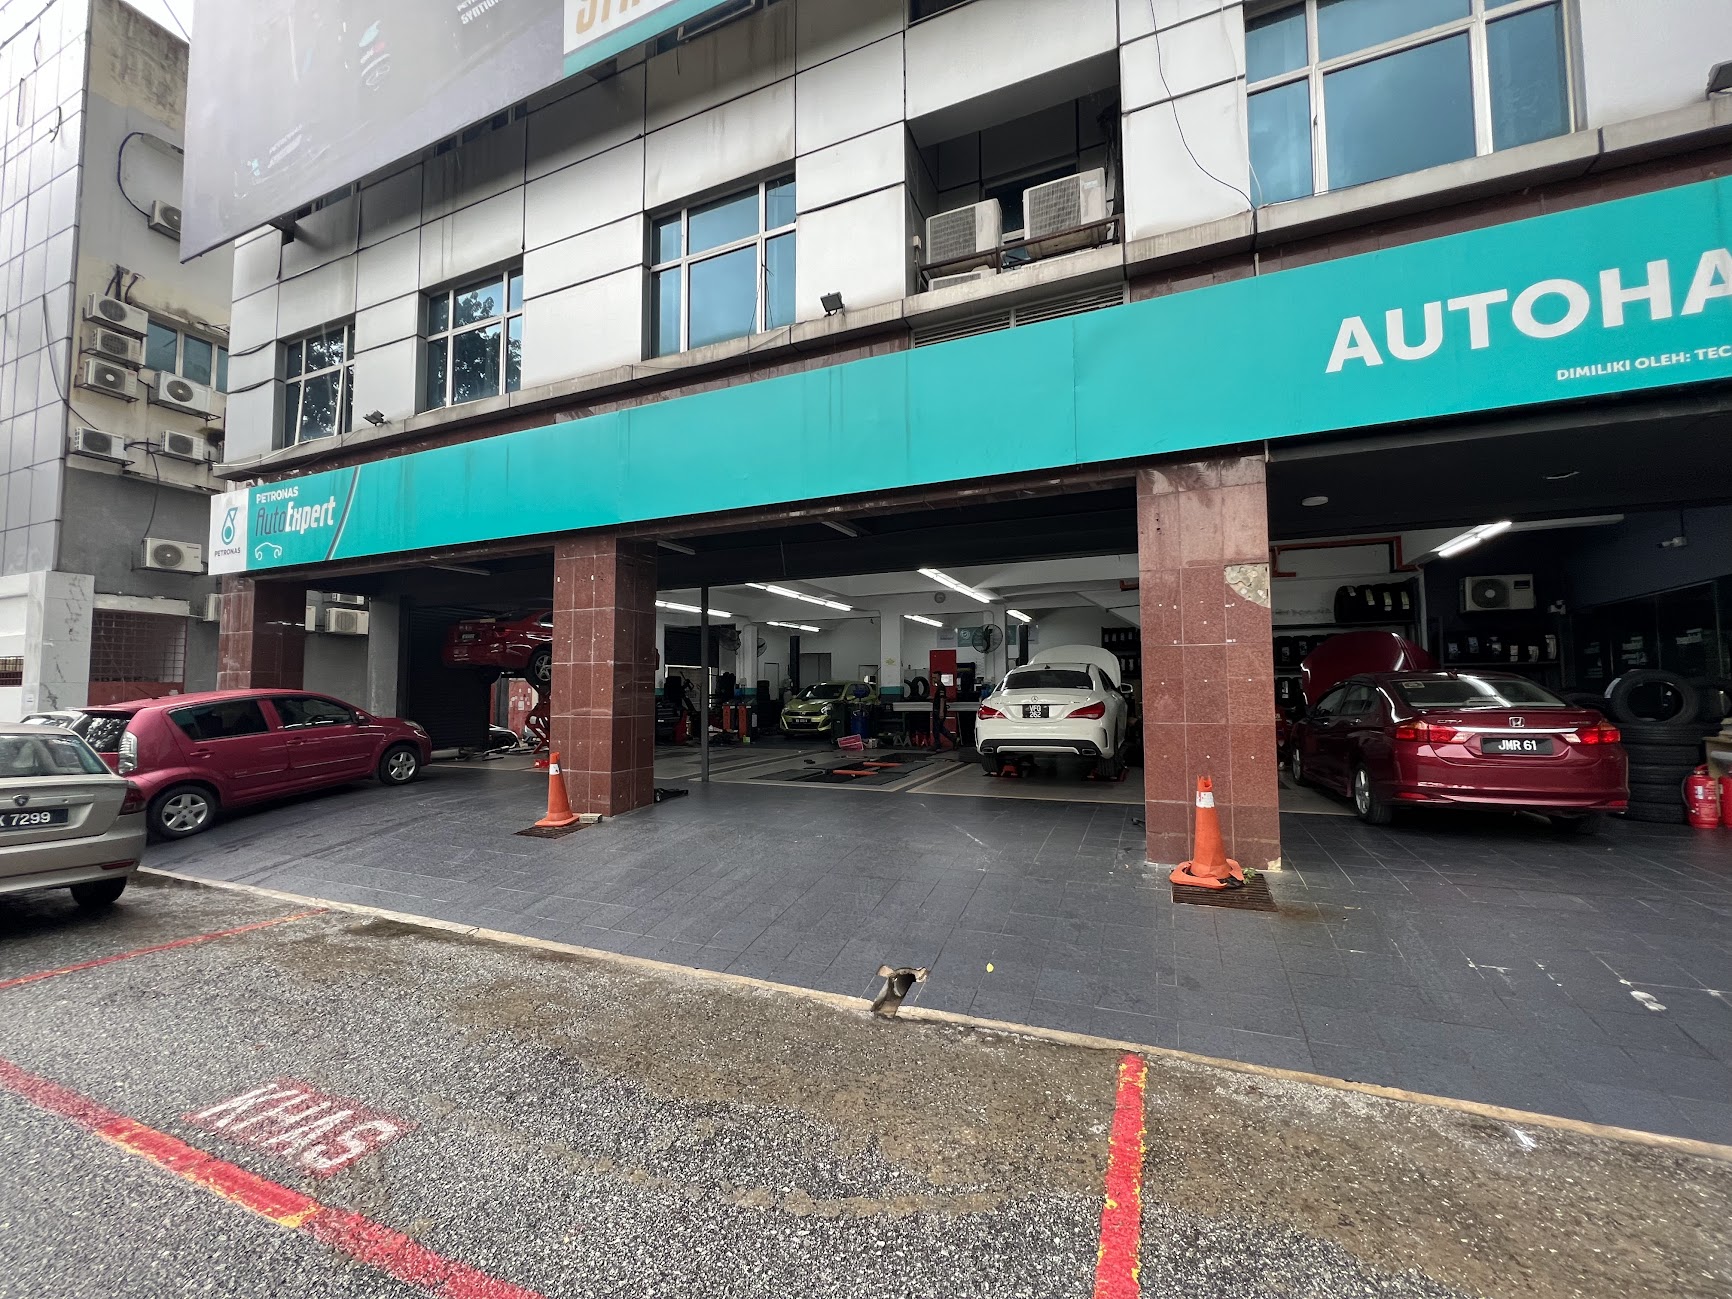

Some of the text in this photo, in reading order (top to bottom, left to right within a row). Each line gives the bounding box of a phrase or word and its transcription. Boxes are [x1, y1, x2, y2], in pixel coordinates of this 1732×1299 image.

[461, 0, 499, 24] SYNTIU
[1325, 248, 1732, 373] AUTOHA
[1557, 345, 1732, 381] DIMILIKI OLEH: TEC
[256, 486, 299, 504] PETRONAS
[214, 547, 241, 557] PETRONAS
[1498, 739, 1537, 751] JMR 61
[10, 812, 51, 826] 7299
